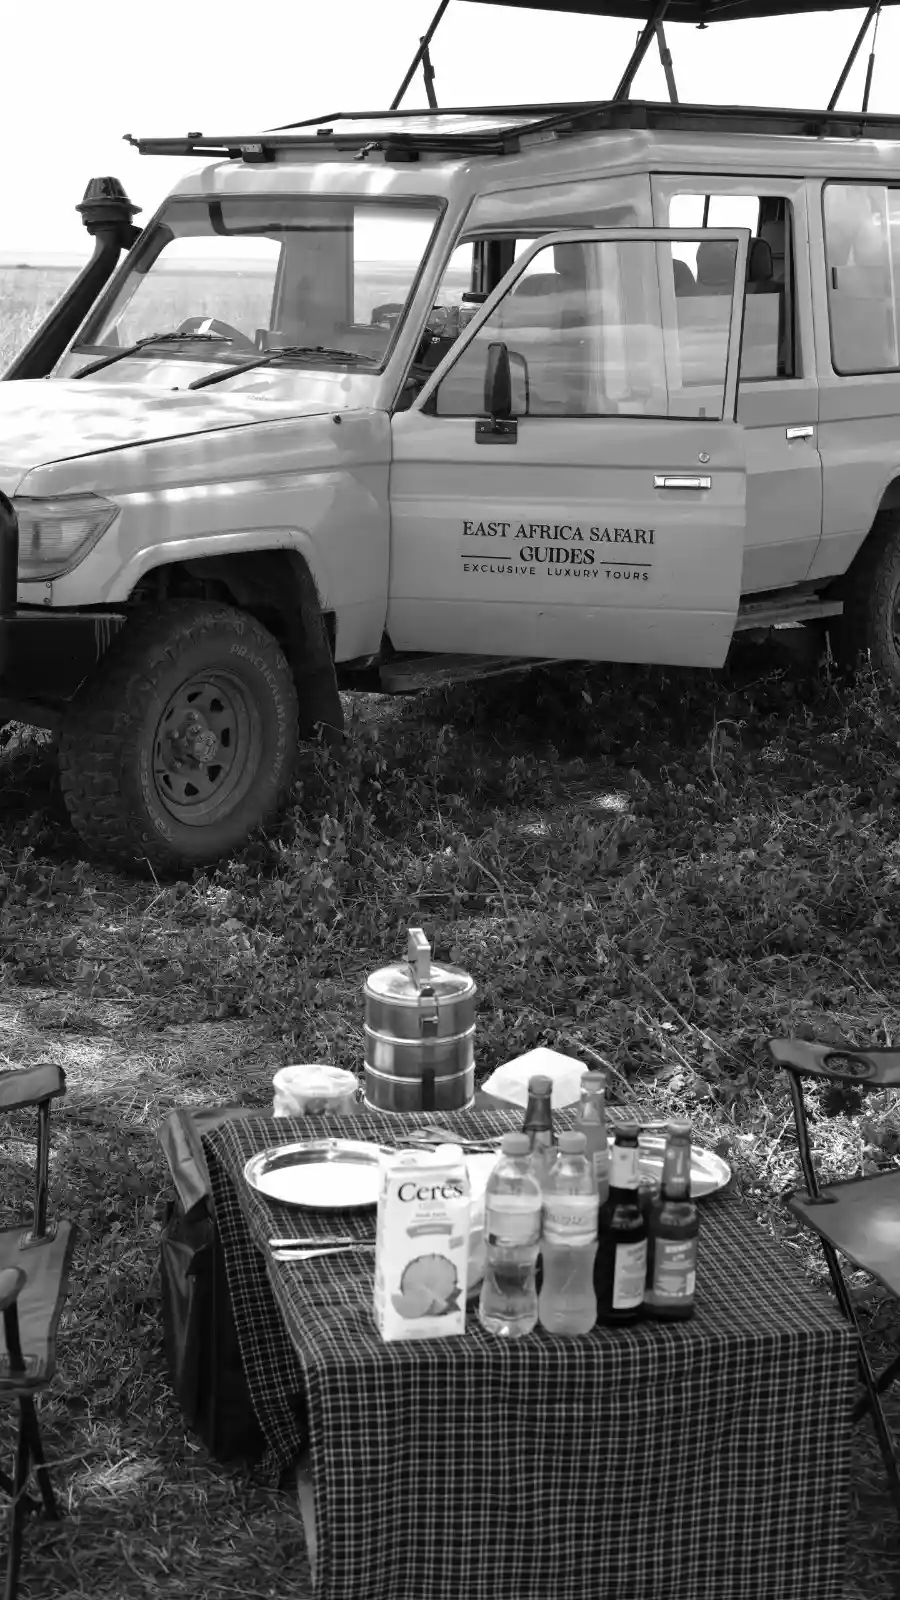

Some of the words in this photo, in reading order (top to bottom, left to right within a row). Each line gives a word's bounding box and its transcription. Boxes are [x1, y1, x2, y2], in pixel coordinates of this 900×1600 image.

[462, 521, 511, 537] EAST
[514, 524, 585, 541] AFRICA
[589, 527, 656, 545] SAFARI
[519, 546, 595, 565] GUIDES
[463, 563, 537, 575] EXCLUSIVE
[547, 567, 599, 578] LUXURY
[605, 570, 649, 581] TOURS
[397, 1181, 463, 1203] Ceres
